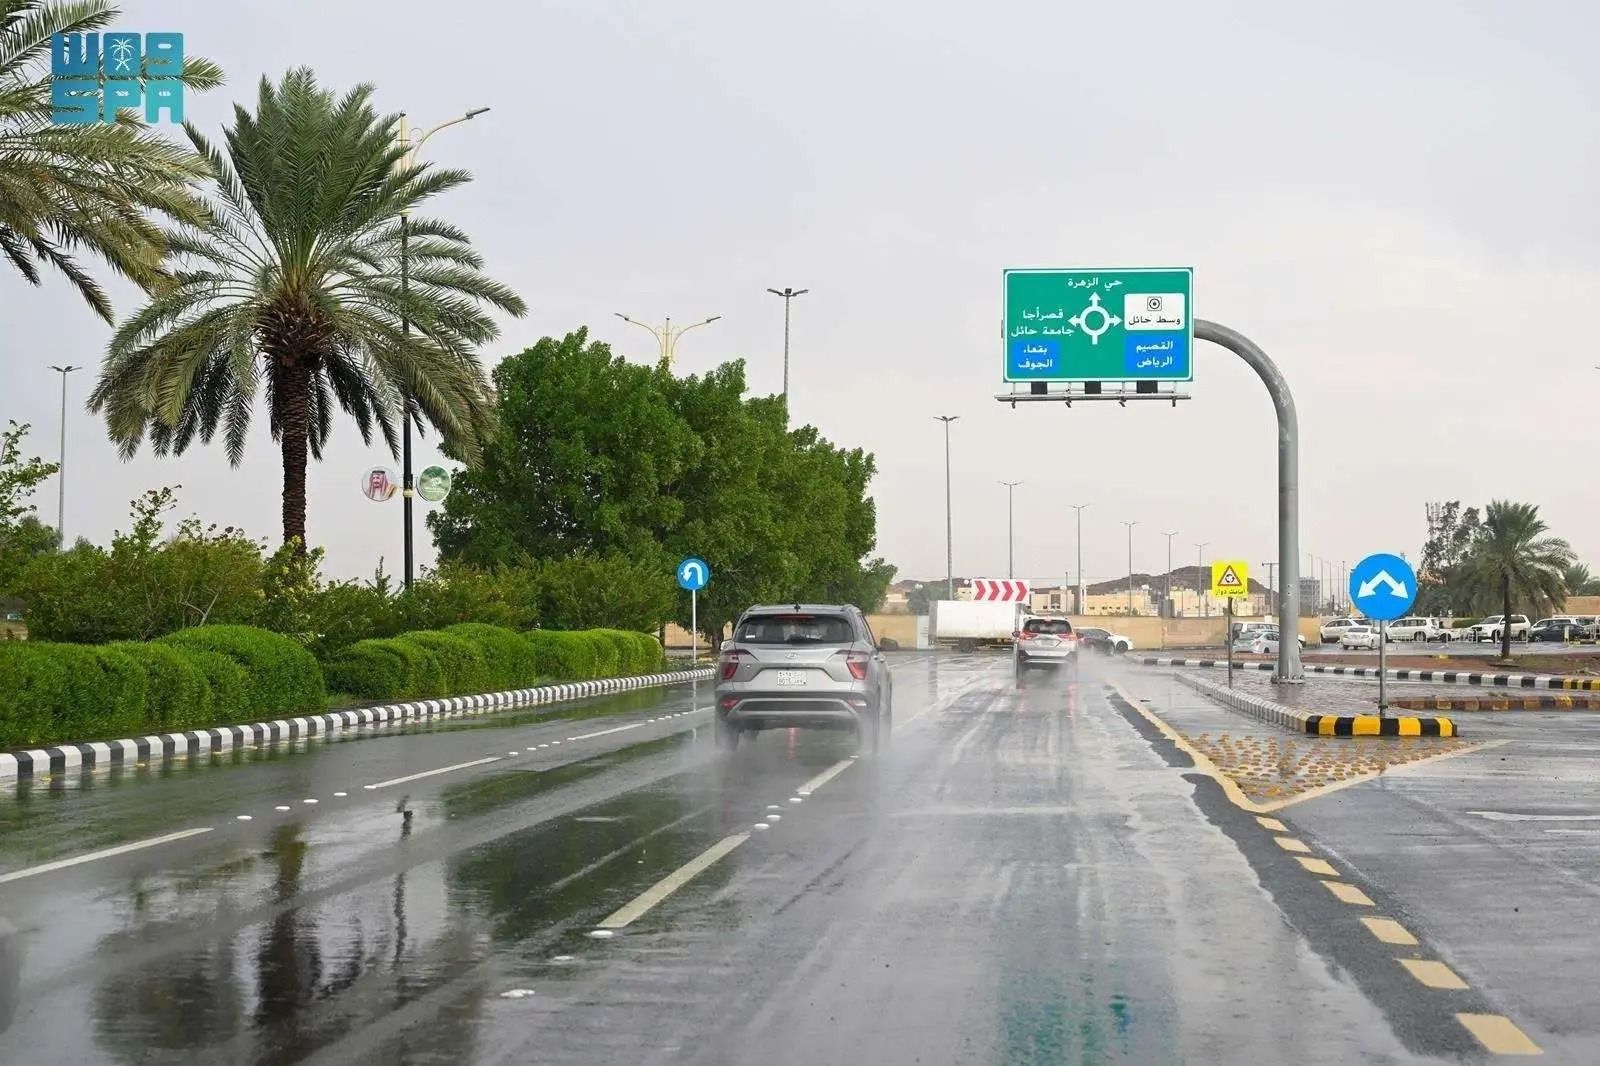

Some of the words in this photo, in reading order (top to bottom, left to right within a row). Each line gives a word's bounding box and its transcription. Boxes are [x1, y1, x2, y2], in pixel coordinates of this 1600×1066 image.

[1067, 277, 1099, 289] الزهرة
[1104, 279, 1123, 291] حي
[1128, 315, 1152, 326] حائل
[1156, 315, 1181, 325] وسط
[1010, 325, 1038, 337] حائل
[1042, 325, 1075, 337] جامعة
[1023, 344, 1048, 356] بقعاء
[1135, 340, 1174, 354] القصيم
[1017, 358, 1053, 370] الجوف
[1136, 355, 1173, 368] الرياض
